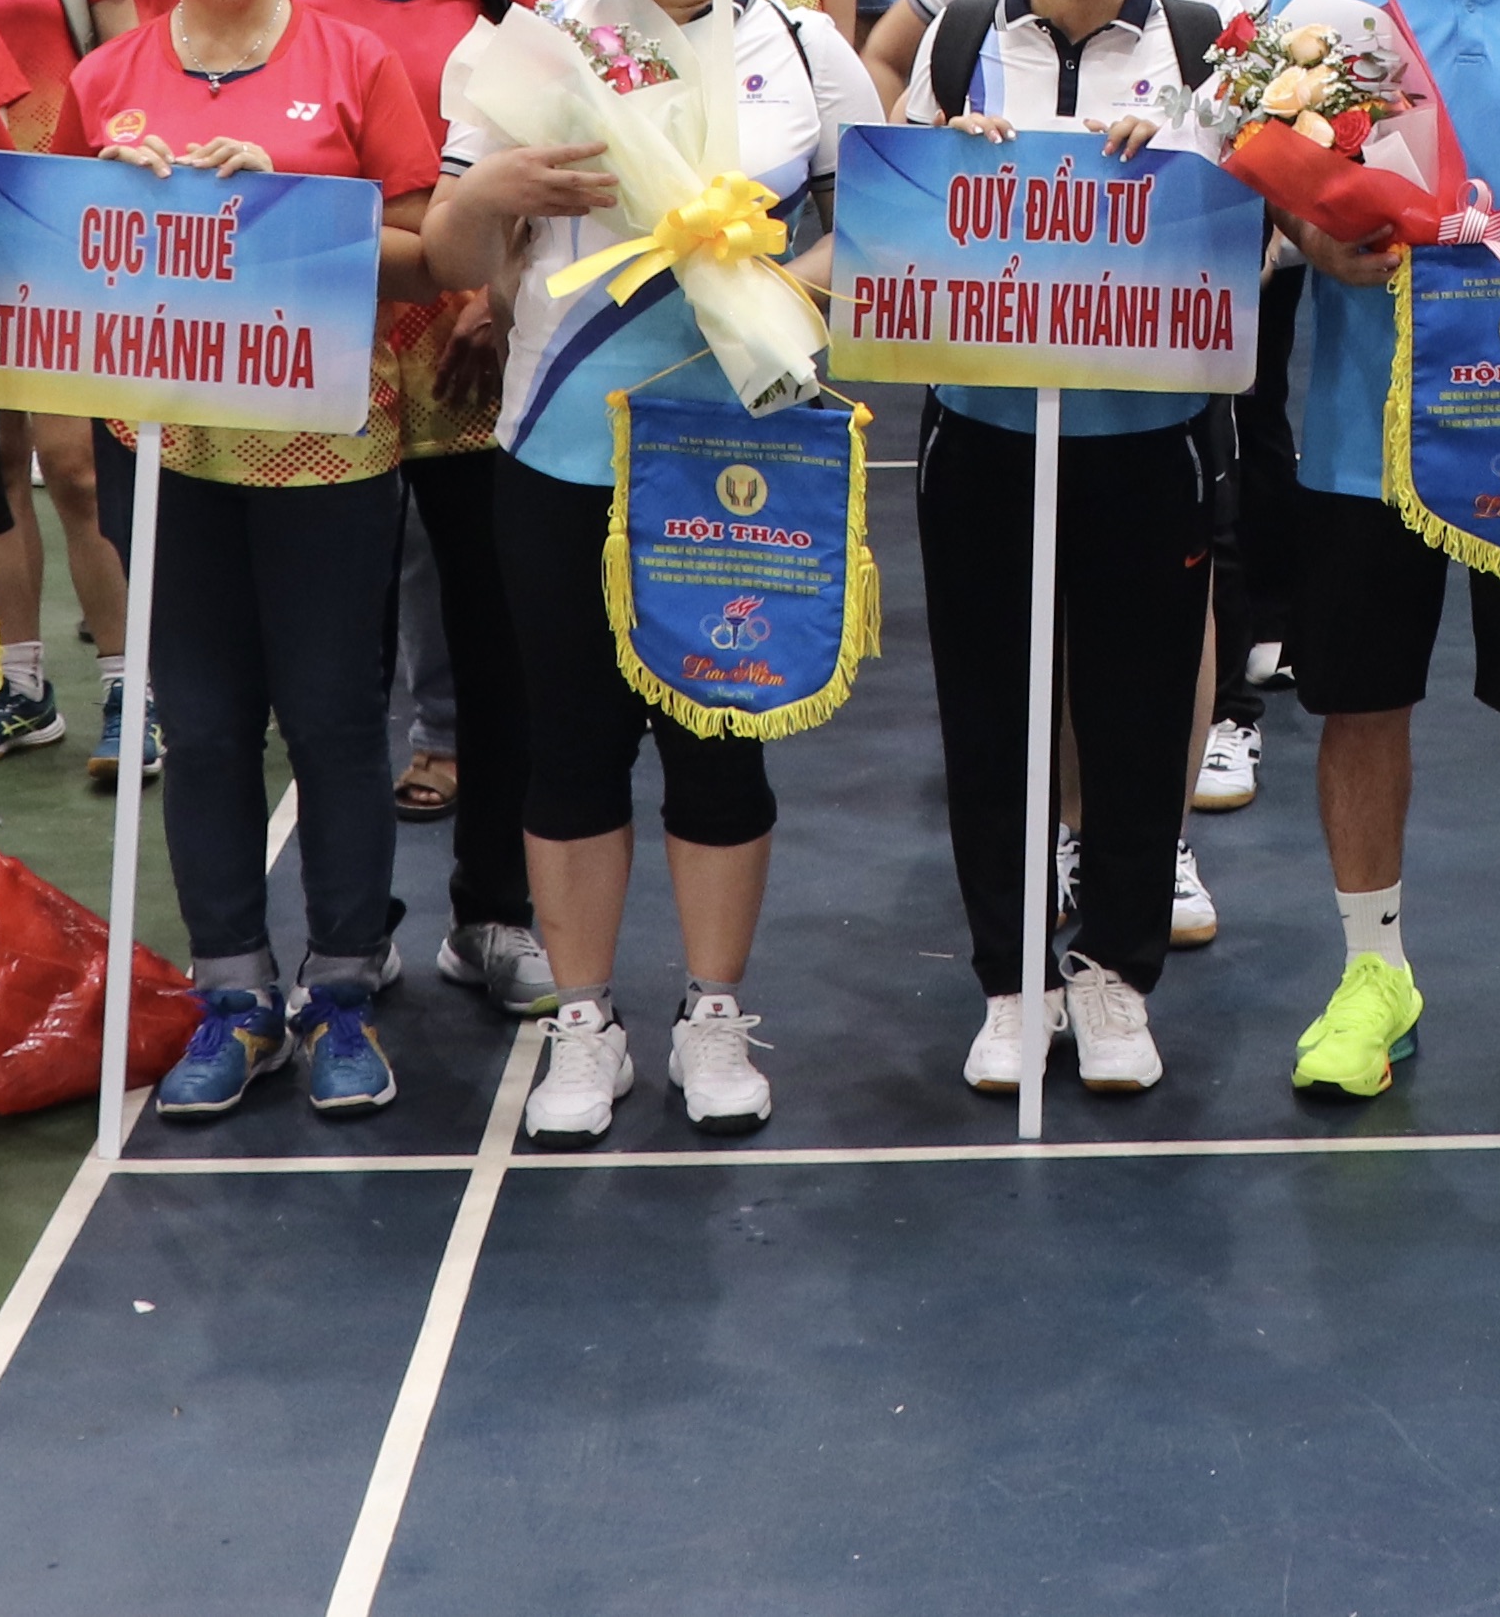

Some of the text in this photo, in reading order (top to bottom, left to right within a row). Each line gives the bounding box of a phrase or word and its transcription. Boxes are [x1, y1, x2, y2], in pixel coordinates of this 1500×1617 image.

[80, 195, 244, 288] CỤC THUẾ
[947, 155, 1154, 247] QUỸ ĐẦU TƯ
[93, 304, 227, 383] KHÁNH
[237, 309, 315, 389] HÒA
[853, 254, 1233, 351] PHÁT TRIỂN KHÁNH HÒA
[664, 516, 812, 548] HỘI THAO
